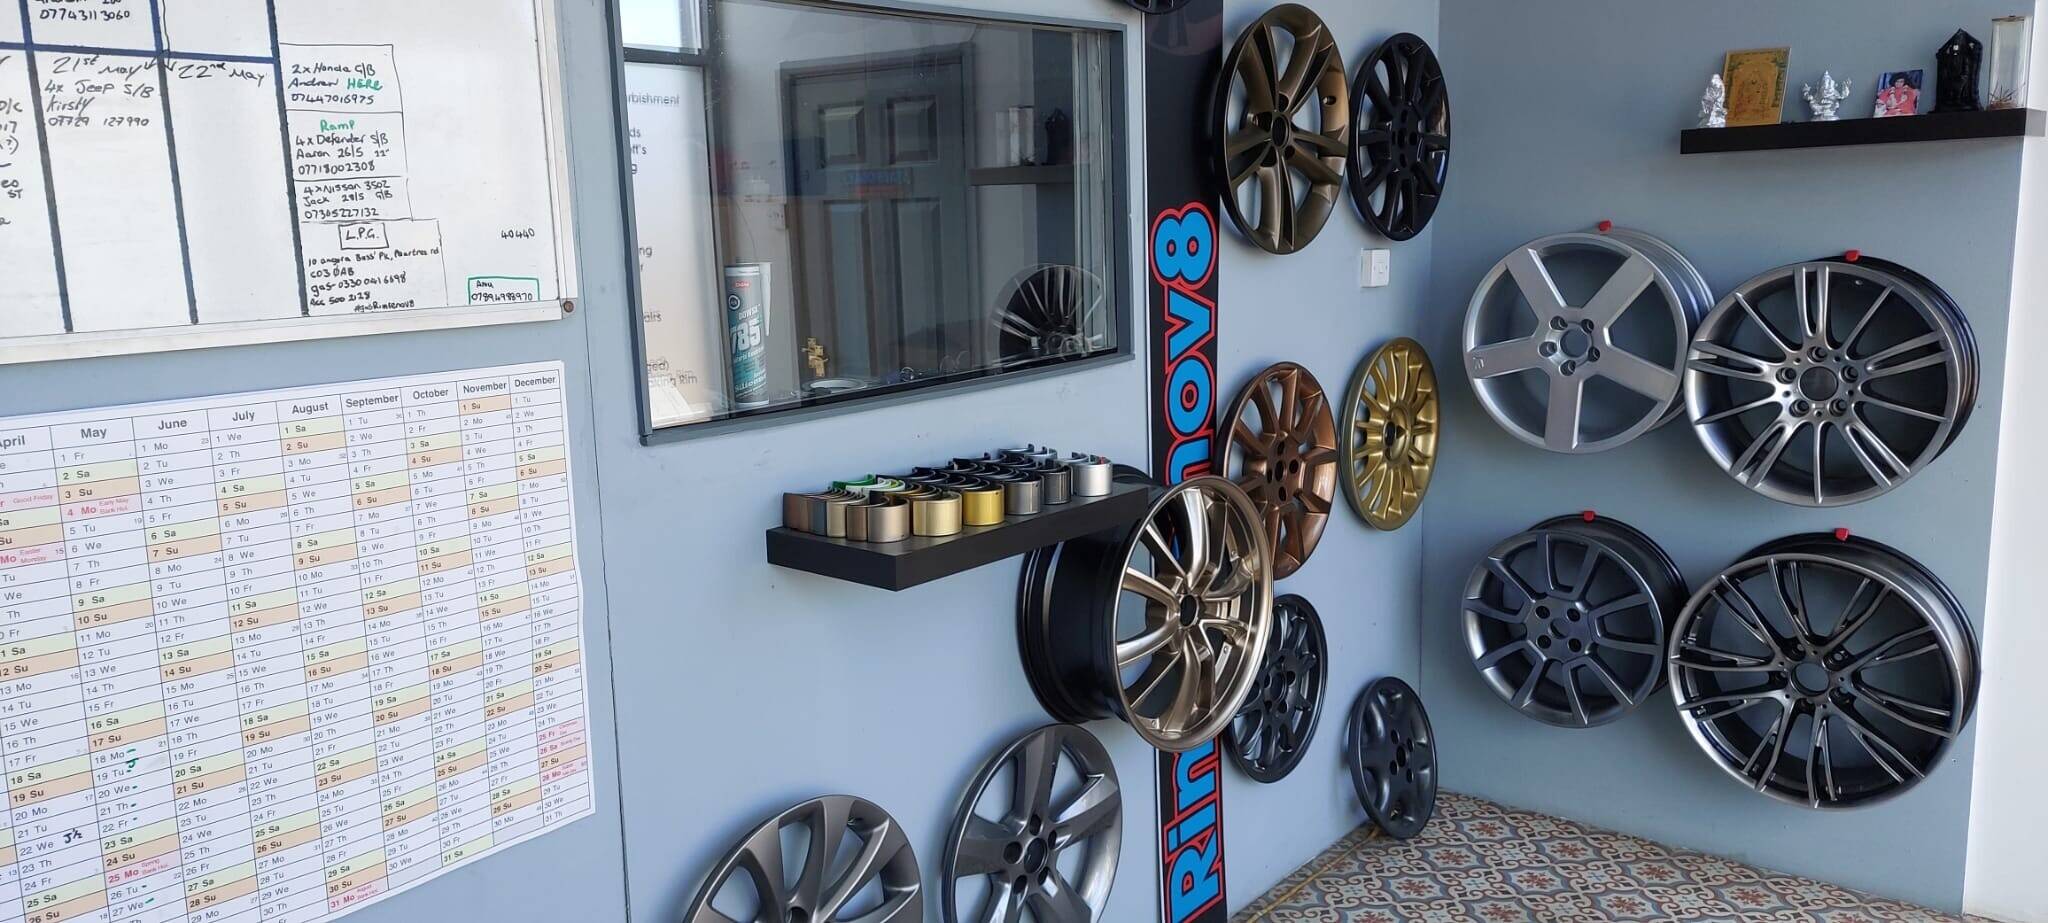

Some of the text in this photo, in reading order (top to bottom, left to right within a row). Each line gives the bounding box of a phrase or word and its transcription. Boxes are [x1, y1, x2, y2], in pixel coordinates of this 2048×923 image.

[463, 381, 507, 394] November
[514, 376, 556, 388] December
[413, 389, 448, 400] October
[346, 394, 398, 408] September
[292, 402, 328, 415] August
[232, 410, 255, 422] July
[158, 420, 187, 430] June
[80, 428, 107, 439] May
[143, 460, 168, 470] 2 Tu
[62, 470, 90, 480] 2 Sa
[65, 488, 93, 499] 3 Su
[221, 484, 245, 494] 4 Sa
[81, 506, 97, 515] Mo
[223, 501, 247, 511] 5 Su
[151, 530, 176, 540] 6 Sa
[152, 547, 179, 558] 7 Su
[78, 596, 105, 607] 9 Sa
[231, 601, 257, 611] 11 Sa
[77, 613, 108, 625] 10 Su
[233, 617, 259, 628] 12 Su
[164, 666, 192, 677] 14 Su
[91, 718, 119, 729] 16 Sa
[243, 714, 269, 726] 18 Sa
[92, 735, 122, 747] 17 Su
[10, 772, 42, 785] 18 Sa
[176, 781, 204, 795] 21 Su
[13, 790, 44, 803] 19 Su
[15, 807, 48, 821] 20 Mo
[255, 825, 280, 838] 25 Sa
[106, 853, 136, 867] 24 Su
[22, 859, 52, 874] 23 Th
[108, 873, 120, 884] 25
[124, 869, 139, 879] Mo
[187, 879, 215, 892] 27 Sa
